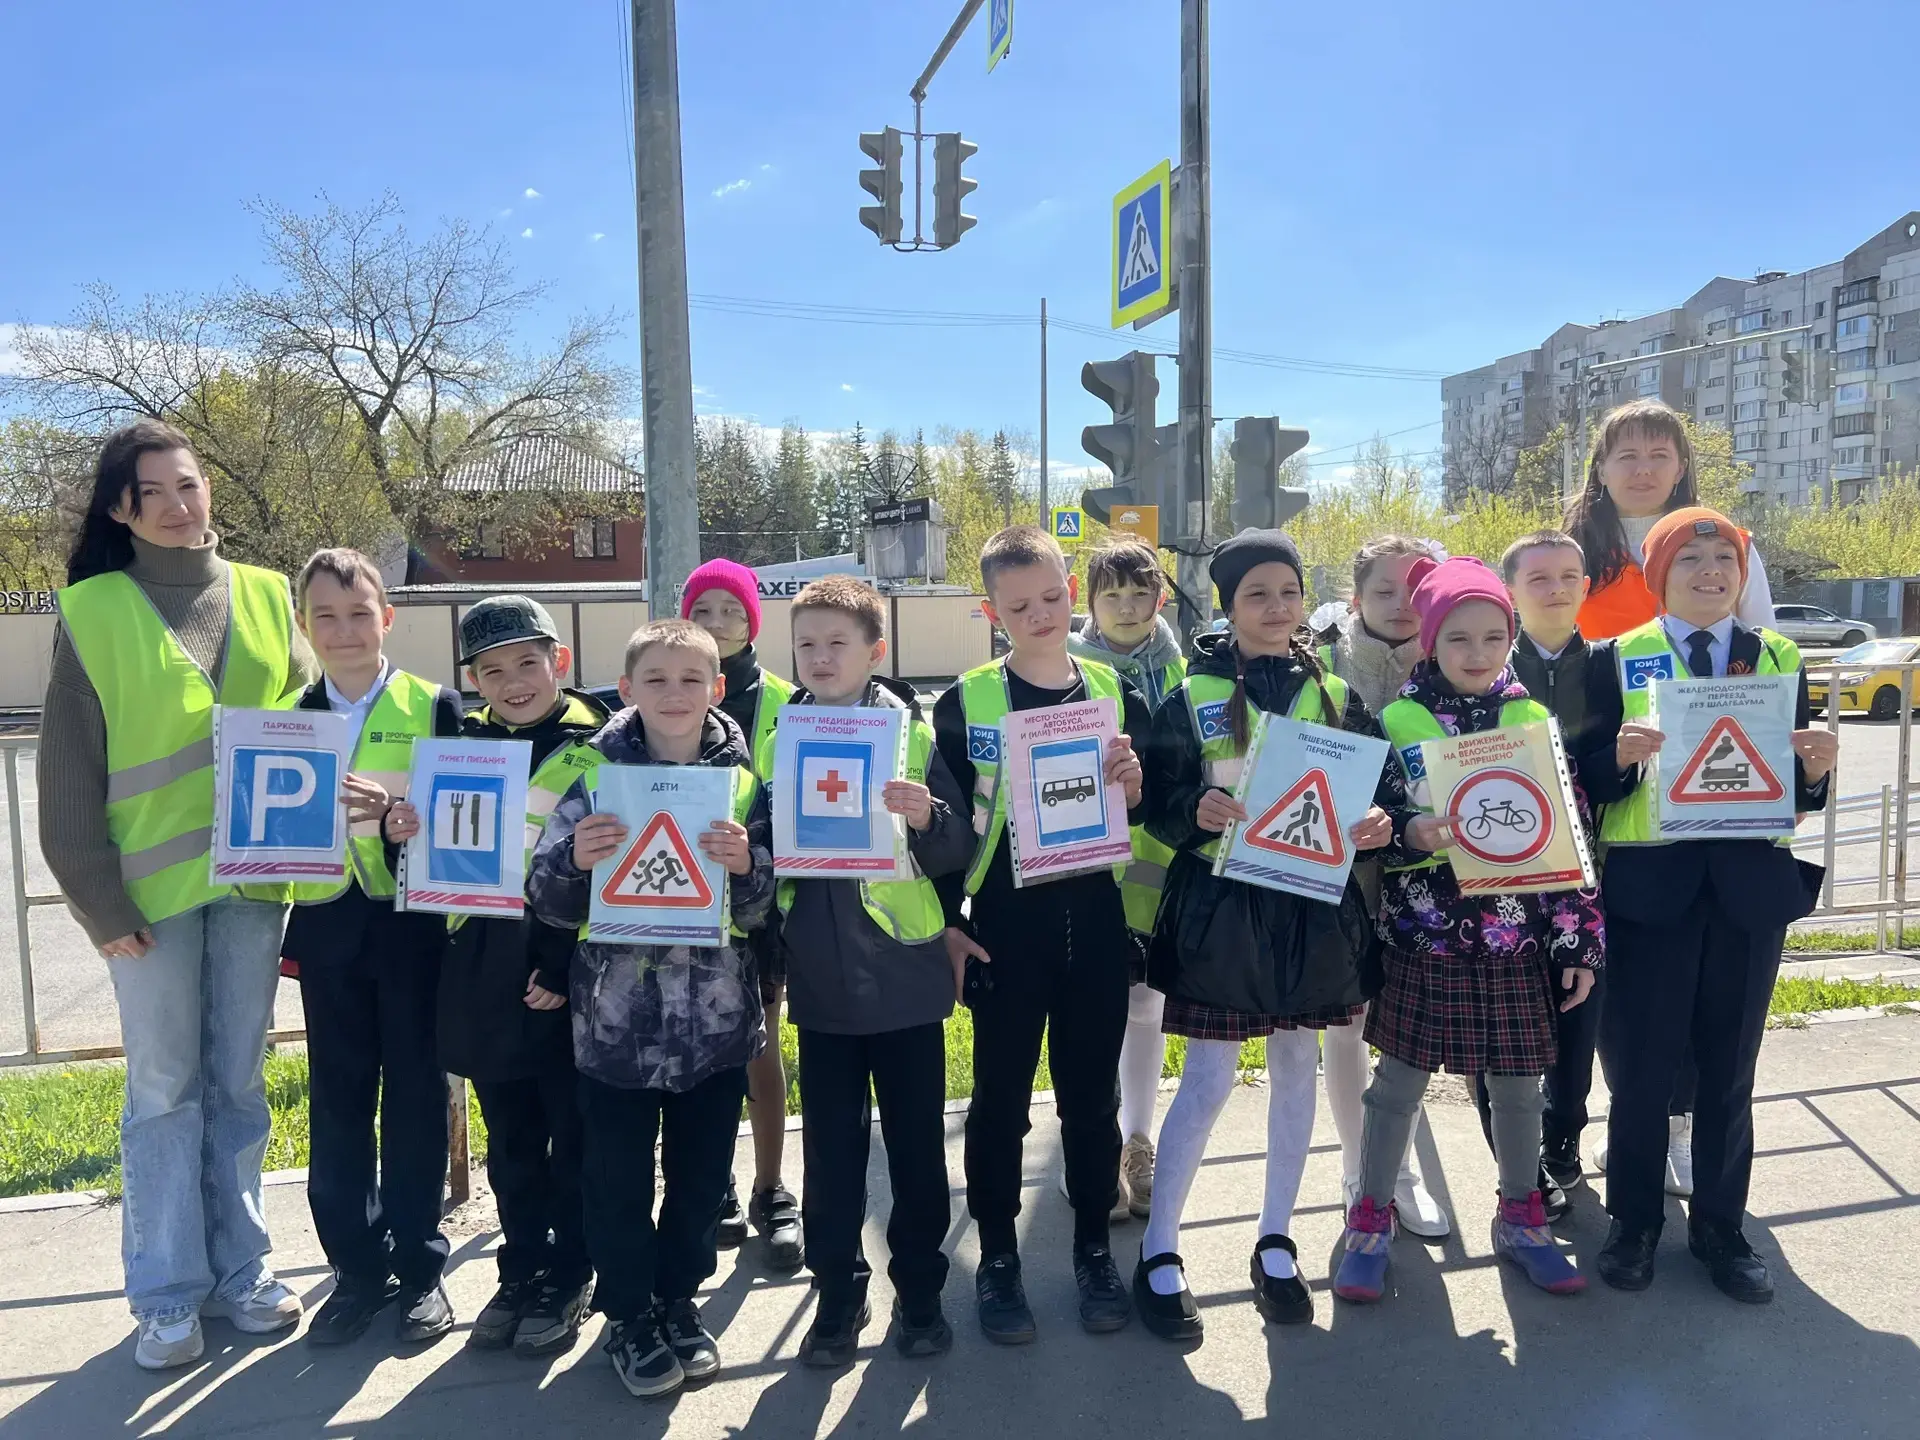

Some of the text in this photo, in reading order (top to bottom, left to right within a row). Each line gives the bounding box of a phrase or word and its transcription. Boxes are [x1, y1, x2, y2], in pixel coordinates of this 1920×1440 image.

[1635, 658, 1661, 668] ЮИД
[1677, 682, 1779, 694] ЖЕЛЕЗНОДОРОЖНЫЙ
[1707, 692, 1747, 701] ПЕРЕЕЗД
[1706, 699, 1765, 708] ШЛАГБАУМА
[1024, 707, 1099, 724] МЕСТО ОСТАНОВКИ
[263, 721, 314, 732] ПАРКОВКА
[788, 715, 887, 728] ПУНКТ МЕДИЦИНСКОЙ
[1043, 718, 1083, 729] АВТОБУСА
[815, 726, 858, 735] ПОМОЩИ
[1052, 721, 1106, 735] ТРОЛЛЕЙБУСА
[973, 729, 995, 740] ЮИД
[1297, 732, 1356, 753] ПЕШЕХОДНЫЙ
[1458, 734, 1507, 750] ДВИЖЕНИЕ
[1305, 744, 1342, 761] ПЕРЕХОД
[1443, 740, 1526, 761] НА ВЕЛОСИПЕДАХ
[438, 754, 507, 764] ПУНКТ ПИТАНИЯ
[1459, 751, 1514, 768] ЗАПРЕЩЕНО
[650, 782, 679, 792] ДЕТИ
